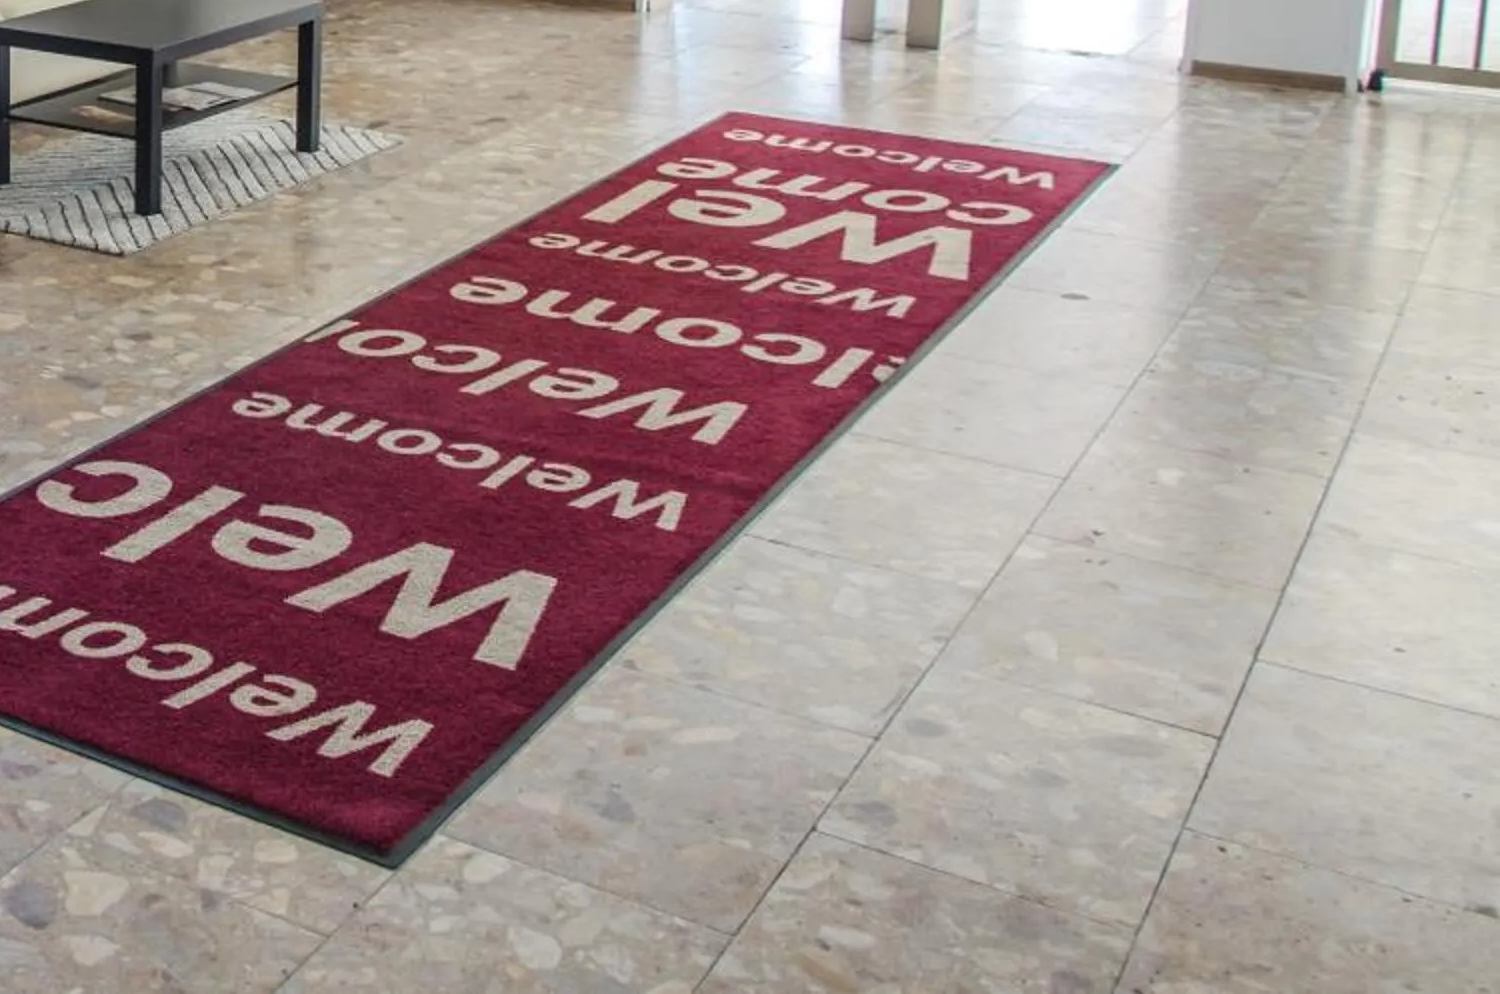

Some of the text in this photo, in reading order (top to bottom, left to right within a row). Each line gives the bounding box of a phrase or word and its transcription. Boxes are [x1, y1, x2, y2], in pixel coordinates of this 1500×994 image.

[656, 157, 1035, 226] come
[722, 127, 1056, 192] Welcome
[528, 232, 918, 319] Welcome
[581, 179, 973, 281] Wel
[305, 319, 748, 445] Welco
[232, 391, 688, 532] Welcome
[36, 460, 558, 671] Welc
